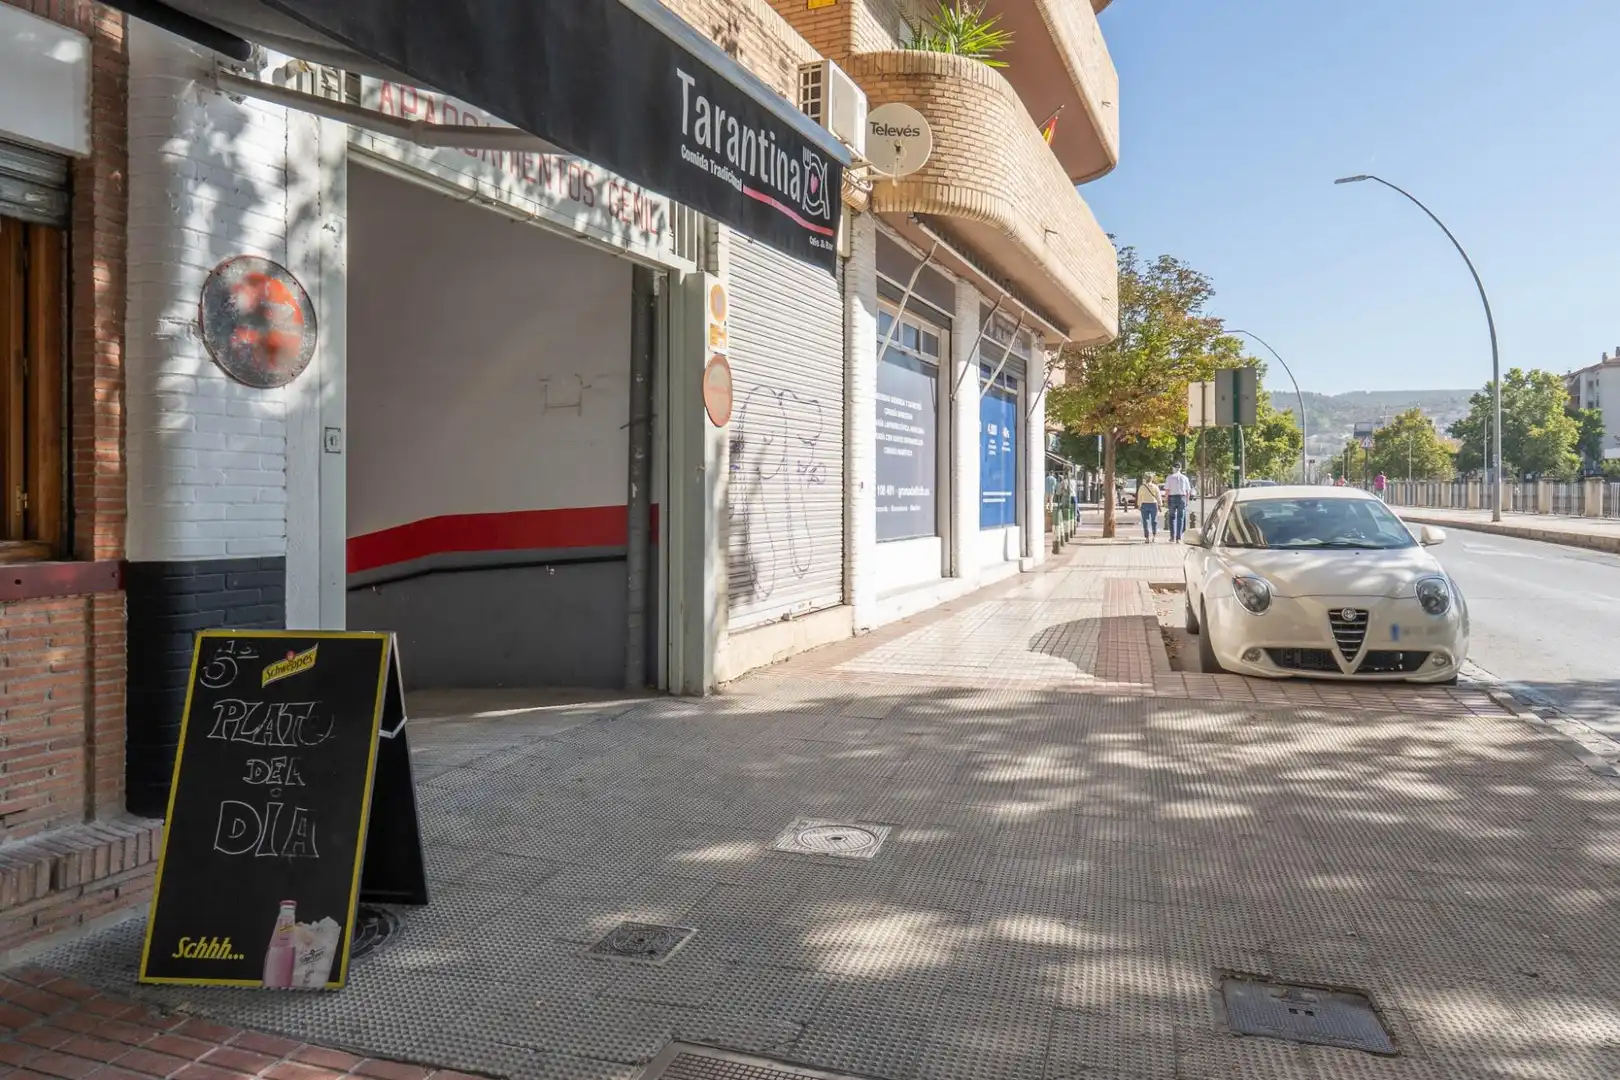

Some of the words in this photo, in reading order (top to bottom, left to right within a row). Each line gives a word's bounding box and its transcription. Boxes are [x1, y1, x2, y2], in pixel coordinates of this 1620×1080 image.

[677, 67, 801, 204] Tarantina
[869, 121, 921, 138] Televés
[681, 144, 709, 172] Comida
[266, 652, 314, 680] Schweppes
